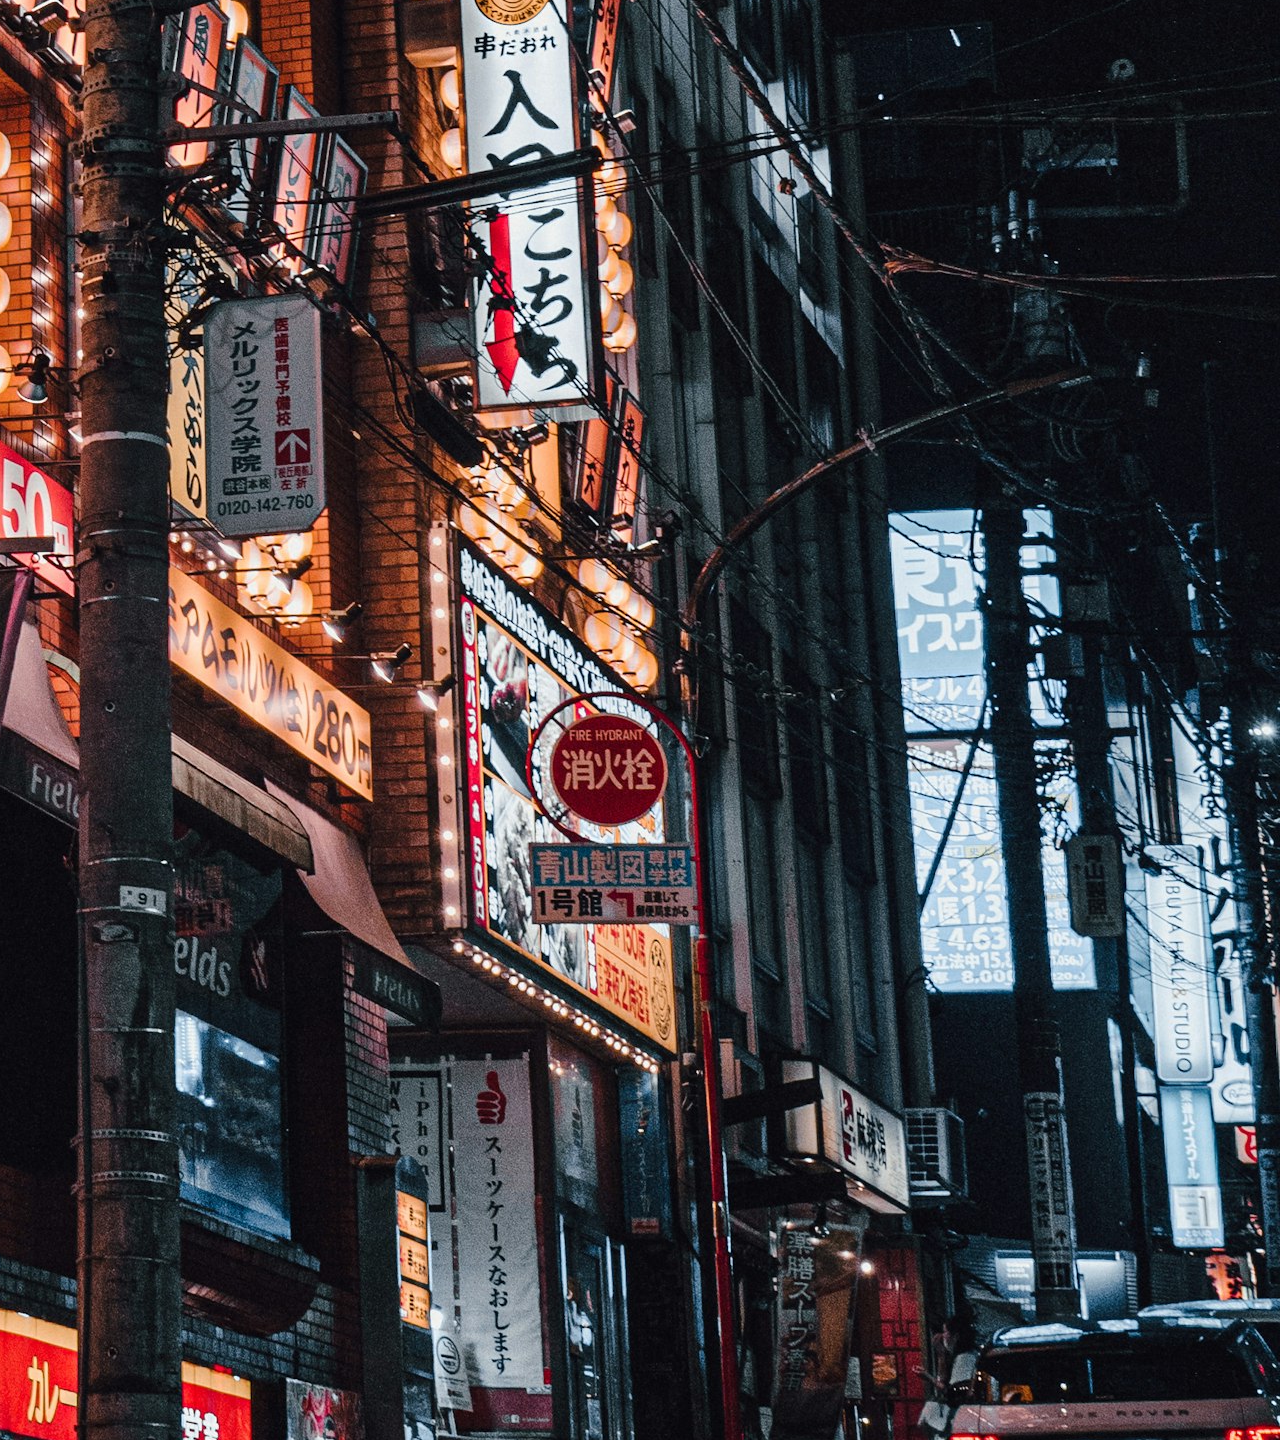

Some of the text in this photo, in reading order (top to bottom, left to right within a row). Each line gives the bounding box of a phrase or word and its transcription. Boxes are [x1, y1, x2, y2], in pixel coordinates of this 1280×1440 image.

[474, 32, 557, 60] 串だおれ
[274, 317, 292, 427] 医歯専門予備校
[230, 321, 263, 474] メルリックス学院
[217, 493, 315, 516] 0120-142-760
[569, 728, 644, 742] FIRE HYDRANT
[561, 747, 657, 791] 消火栓
[536, 849, 687, 885] 青山製図 専門
[648, 868, 688, 885] 学校
[537, 888, 604, 918] 1号館
[1171, 1001, 1193, 1075] STUDIO
[484, 1135, 514, 1379] スーツケースなおします
